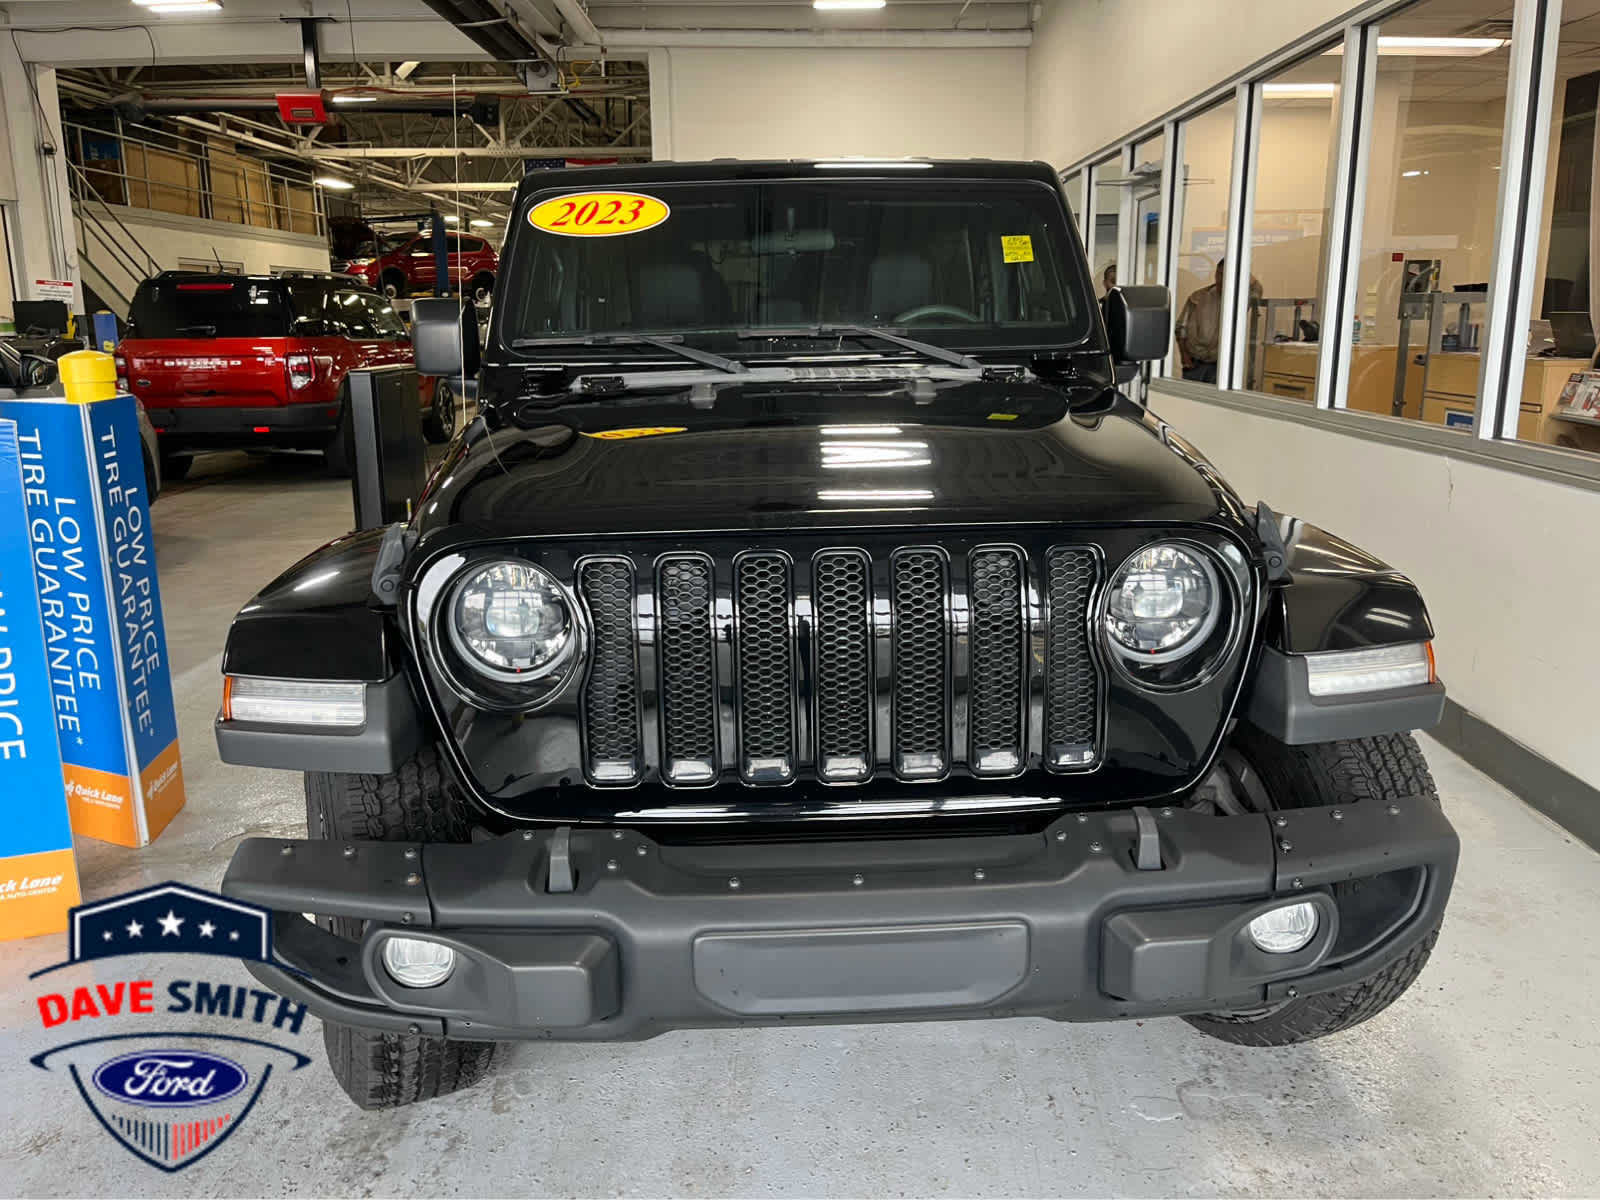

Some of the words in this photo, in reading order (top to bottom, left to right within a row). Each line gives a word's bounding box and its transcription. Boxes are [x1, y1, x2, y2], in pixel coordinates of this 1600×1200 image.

[550, 200, 645, 226] 2023
[19, 428, 50, 507] TIRE
[101, 424, 123, 507] TIRE
[54, 497, 87, 582] LOW
[125, 487, 147, 566] LOW
[136, 577, 160, 675] PRICE
[68, 592, 100, 690] PRICE
